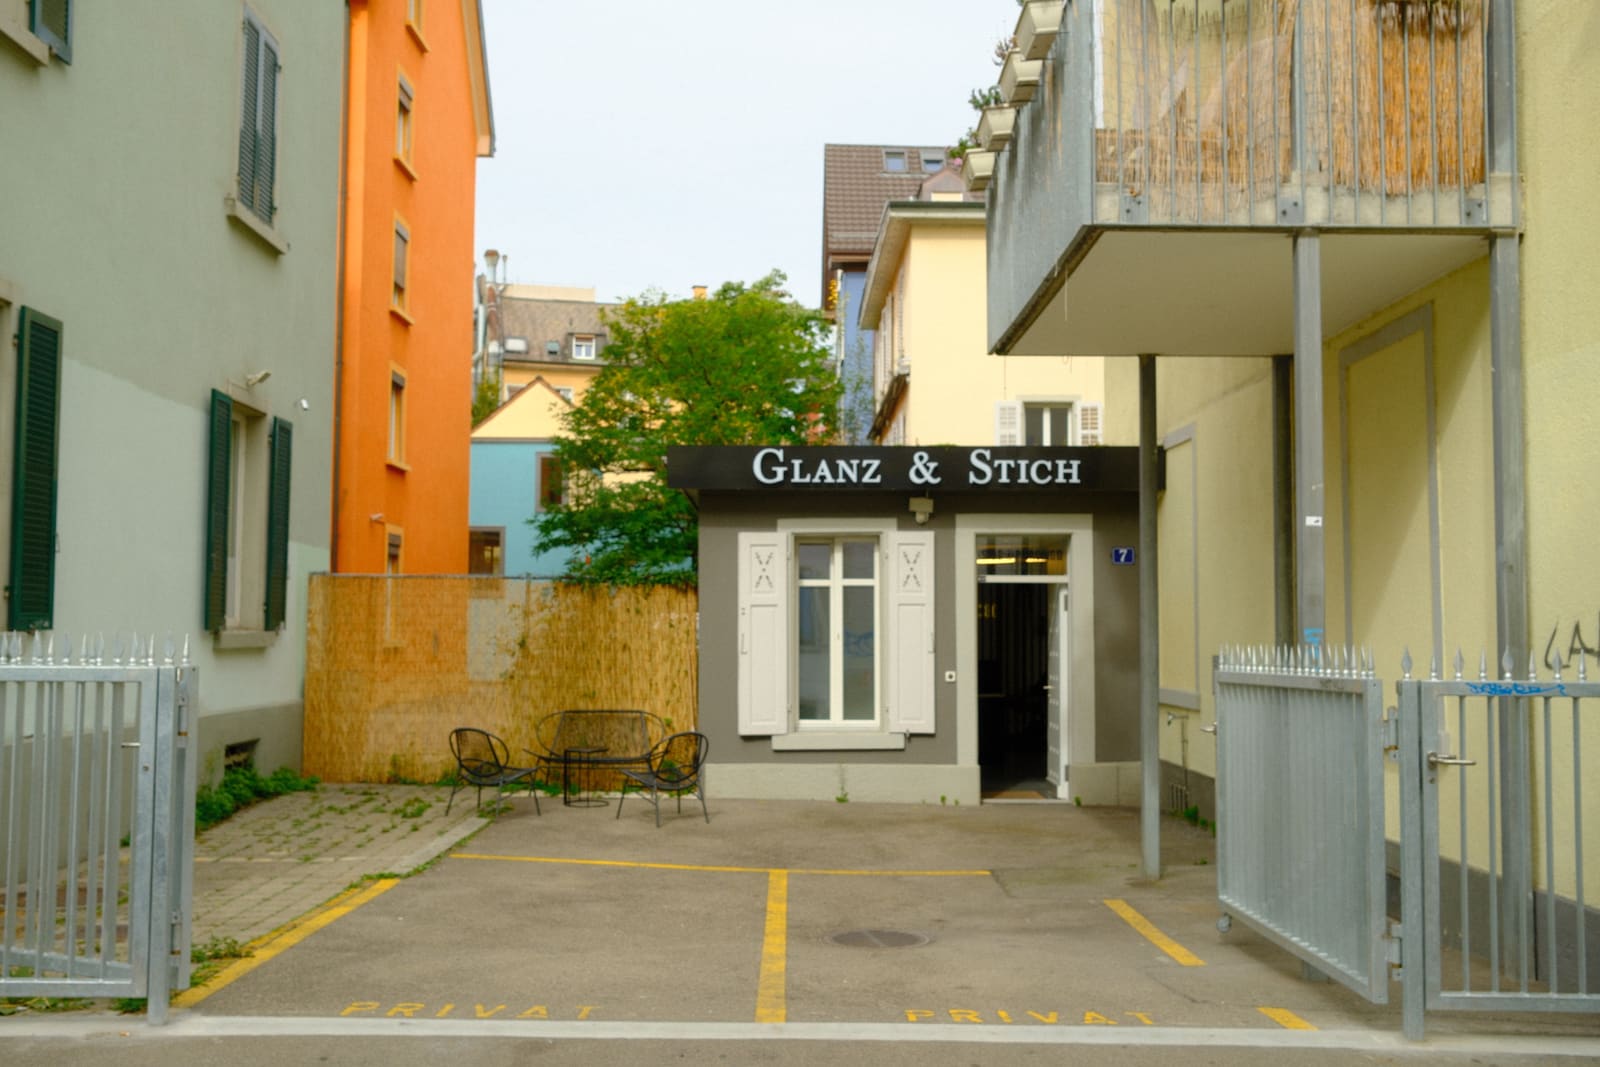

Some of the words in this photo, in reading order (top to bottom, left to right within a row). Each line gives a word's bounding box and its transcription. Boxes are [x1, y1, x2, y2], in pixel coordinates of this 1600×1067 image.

[752, 447, 882, 485] GLANZ
[908, 451, 942, 485] &
[968, 448, 1082, 485] STICH
[1118, 548, 1129, 563] 7
[340, 1001, 602, 1020] PRIVAT
[904, 1008, 1155, 1026] PRIVAT
